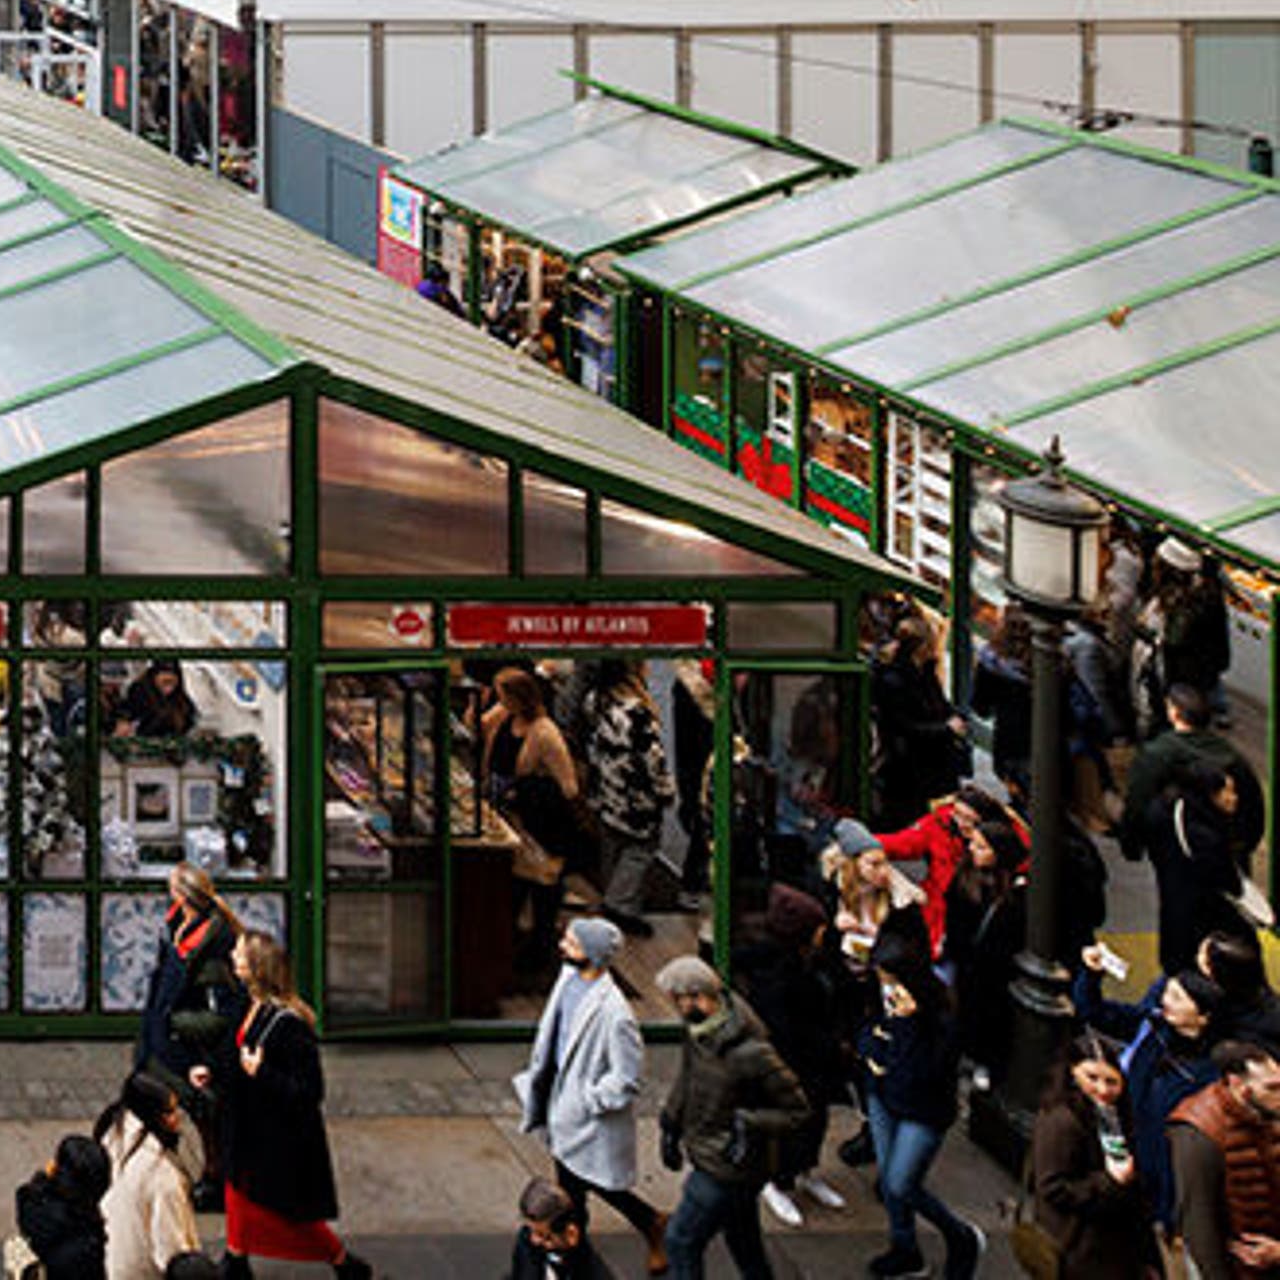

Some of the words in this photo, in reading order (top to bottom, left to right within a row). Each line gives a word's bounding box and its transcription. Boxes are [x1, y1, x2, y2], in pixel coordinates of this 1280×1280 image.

[506, 615, 559, 634] JEWELS
[561, 615, 580, 634] BY
[584, 615, 650, 634] ATLANTIS
